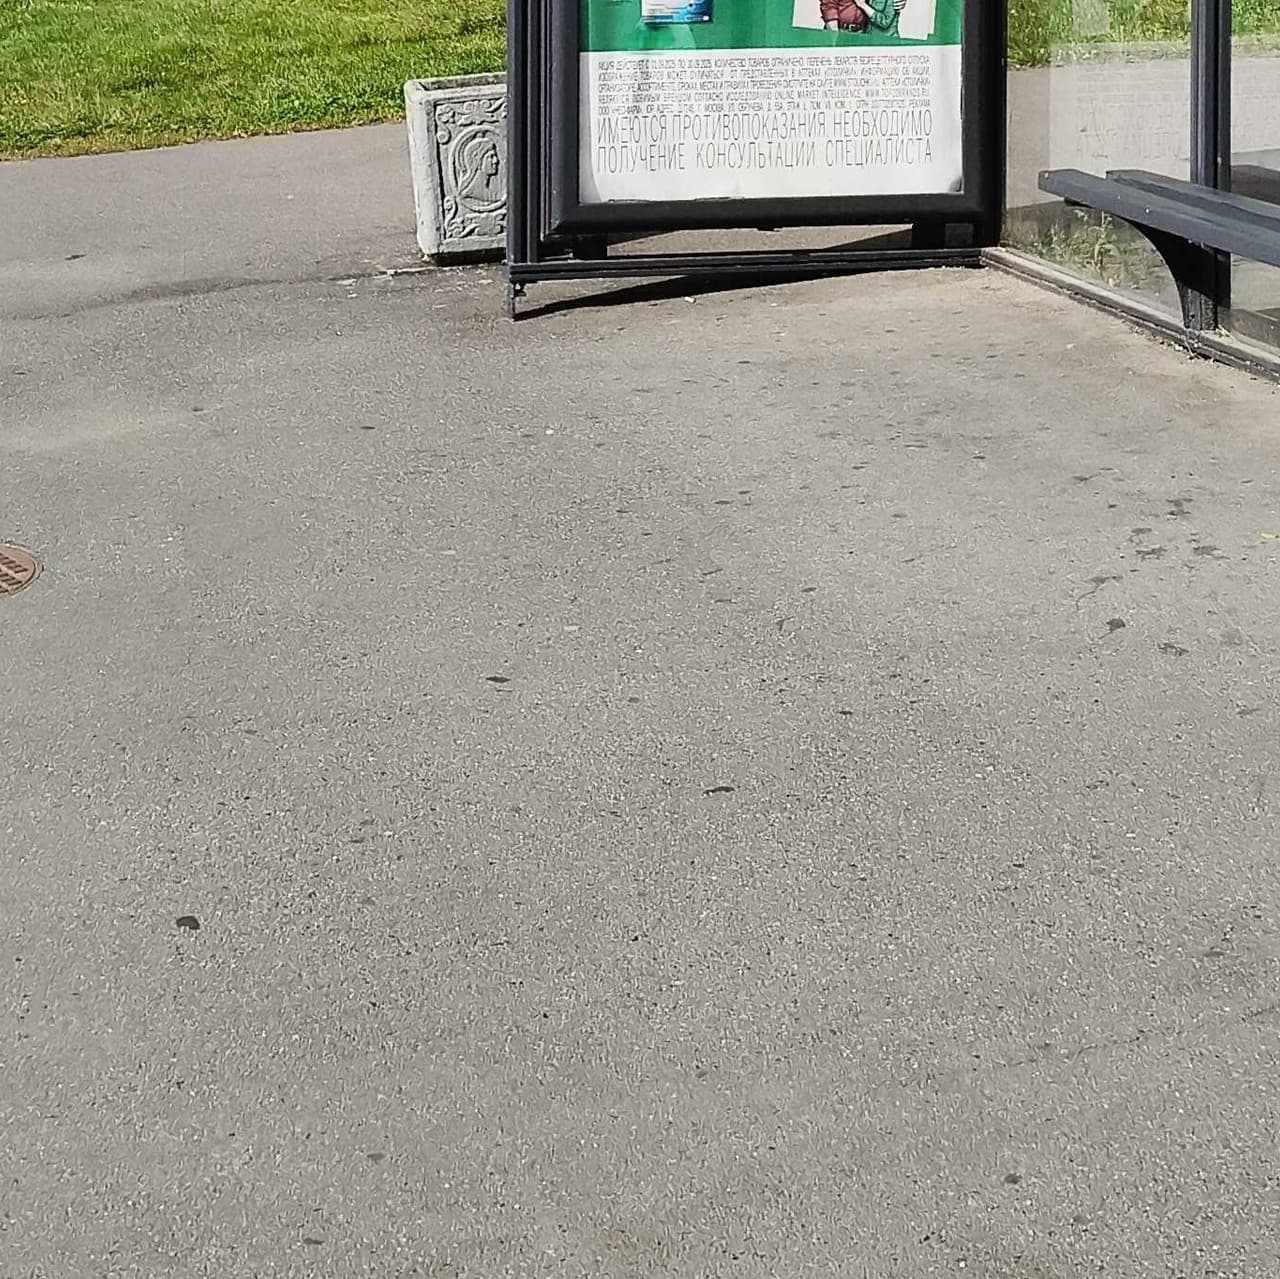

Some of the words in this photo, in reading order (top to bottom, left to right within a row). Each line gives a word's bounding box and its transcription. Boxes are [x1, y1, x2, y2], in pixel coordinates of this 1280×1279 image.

[598, 114, 667, 144] ИМЕЮТСЯ
[833, 109, 933, 138] НЕОБХОДИМО
[597, 142, 685, 174] ПОЛУЧЕНИЕ
[696, 138, 815, 169] КОНСУЛЬТАЦИИ
[825, 137, 932, 168] СПЕЦИАЛИСТА
